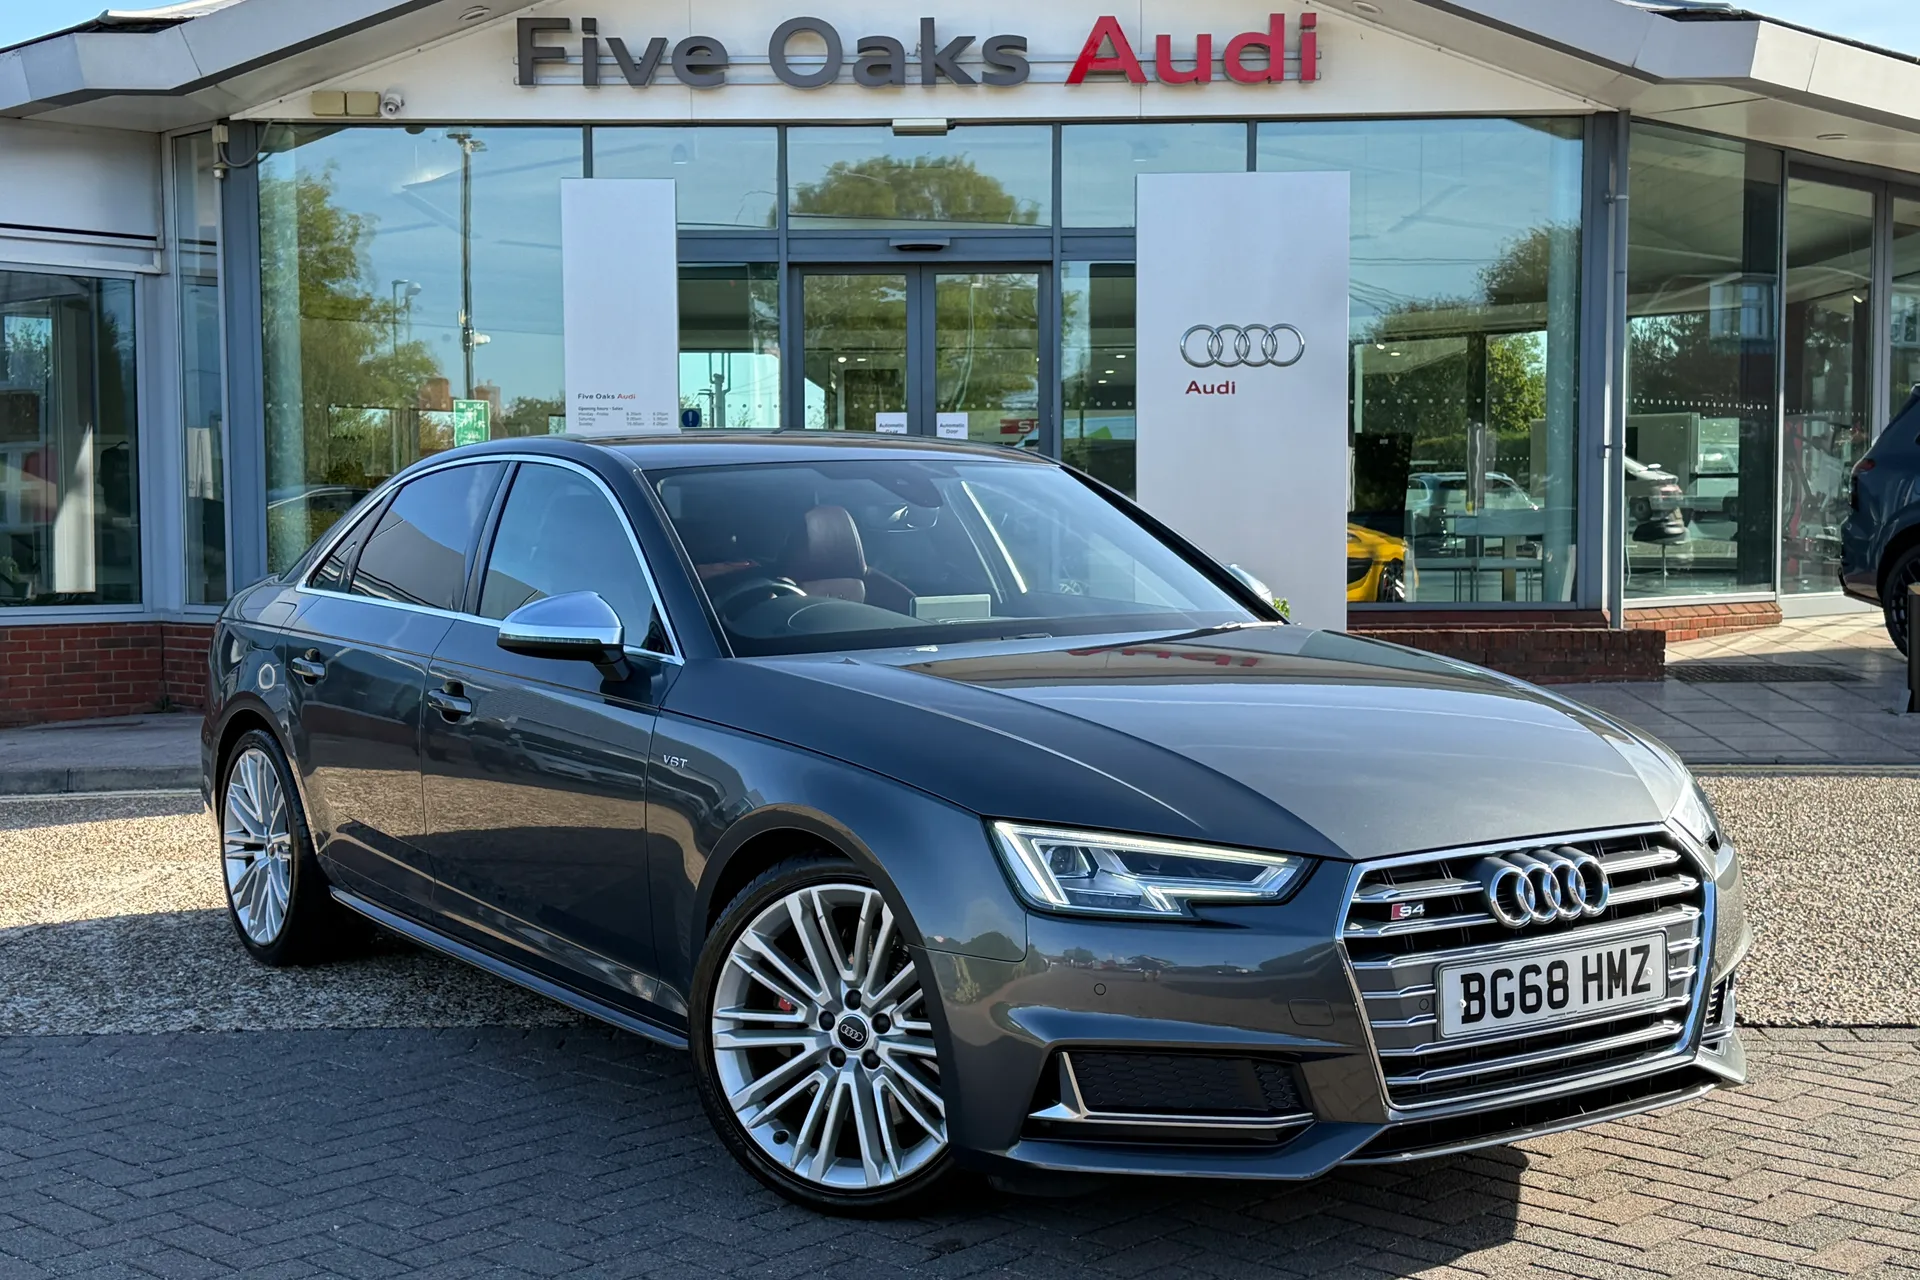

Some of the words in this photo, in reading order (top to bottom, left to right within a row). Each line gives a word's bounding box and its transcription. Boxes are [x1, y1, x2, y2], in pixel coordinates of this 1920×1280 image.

[516, 17, 729, 88] Five
[768, 16, 1030, 89] Oaks
[1064, 13, 1318, 87] Audi
[1185, 380, 1236, 395] Audi
[663, 754, 688, 769] V6T
[1399, 903, 1426, 917] S4
[1460, 959, 1569, 1025] BG68
[1581, 944, 1651, 1005] HMZ
